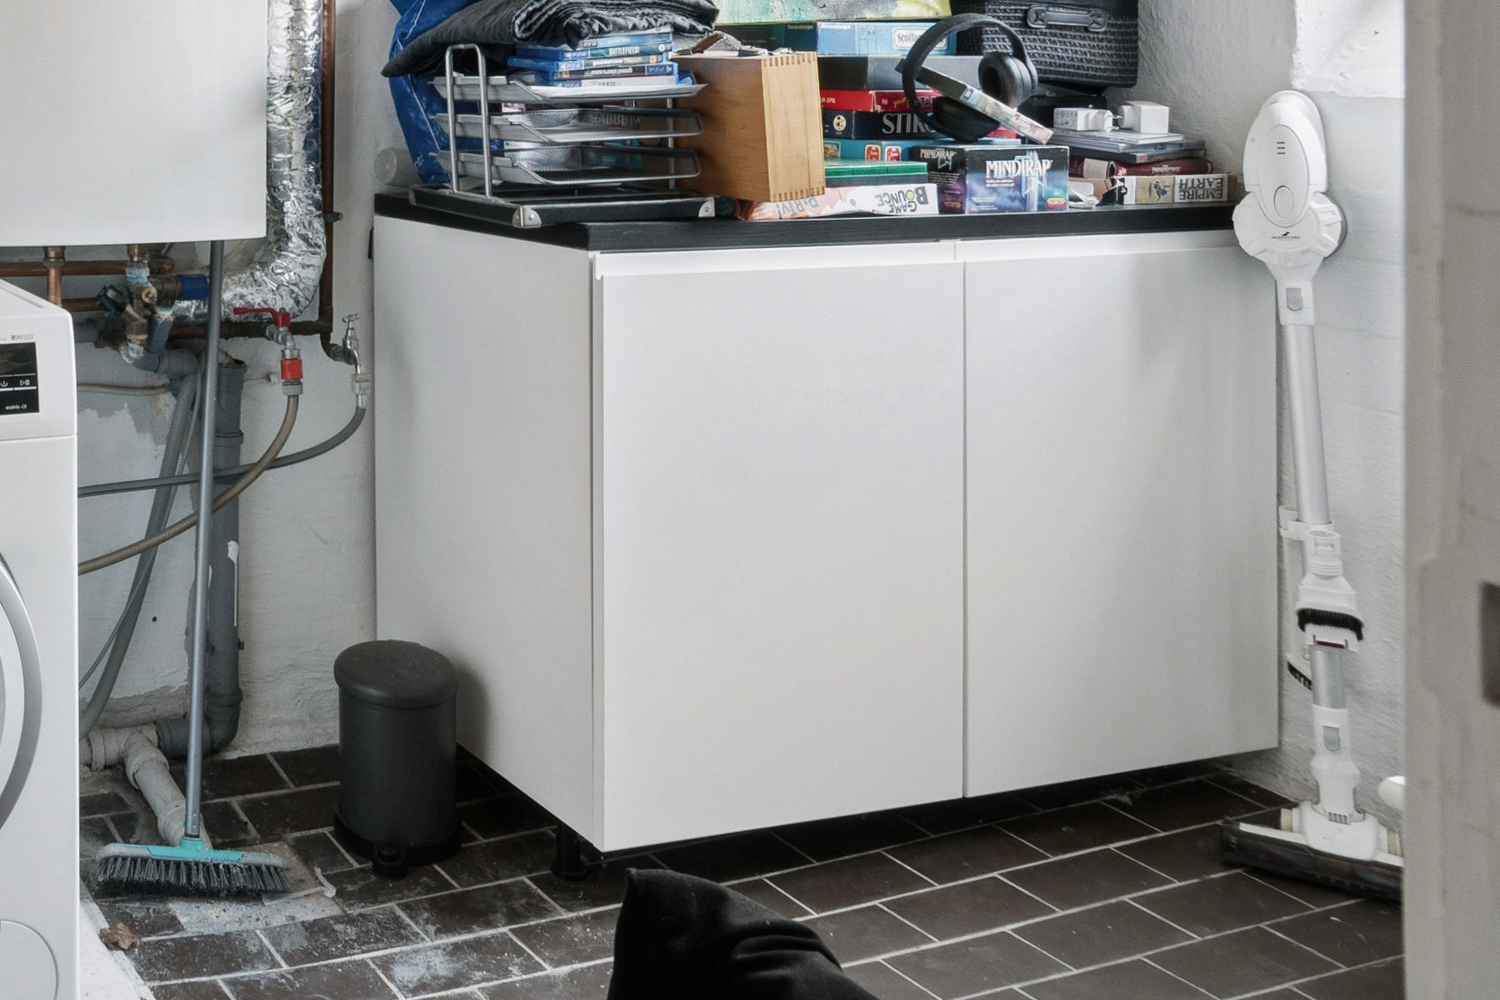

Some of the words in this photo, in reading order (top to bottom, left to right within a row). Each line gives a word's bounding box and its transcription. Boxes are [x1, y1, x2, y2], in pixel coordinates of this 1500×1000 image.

[1179, 178, 1224, 189] EARTH
[875, 185, 929, 207] BOUNCE
[1179, 189, 1223, 200] EMPIRE
[888, 201, 917, 214] GAME
